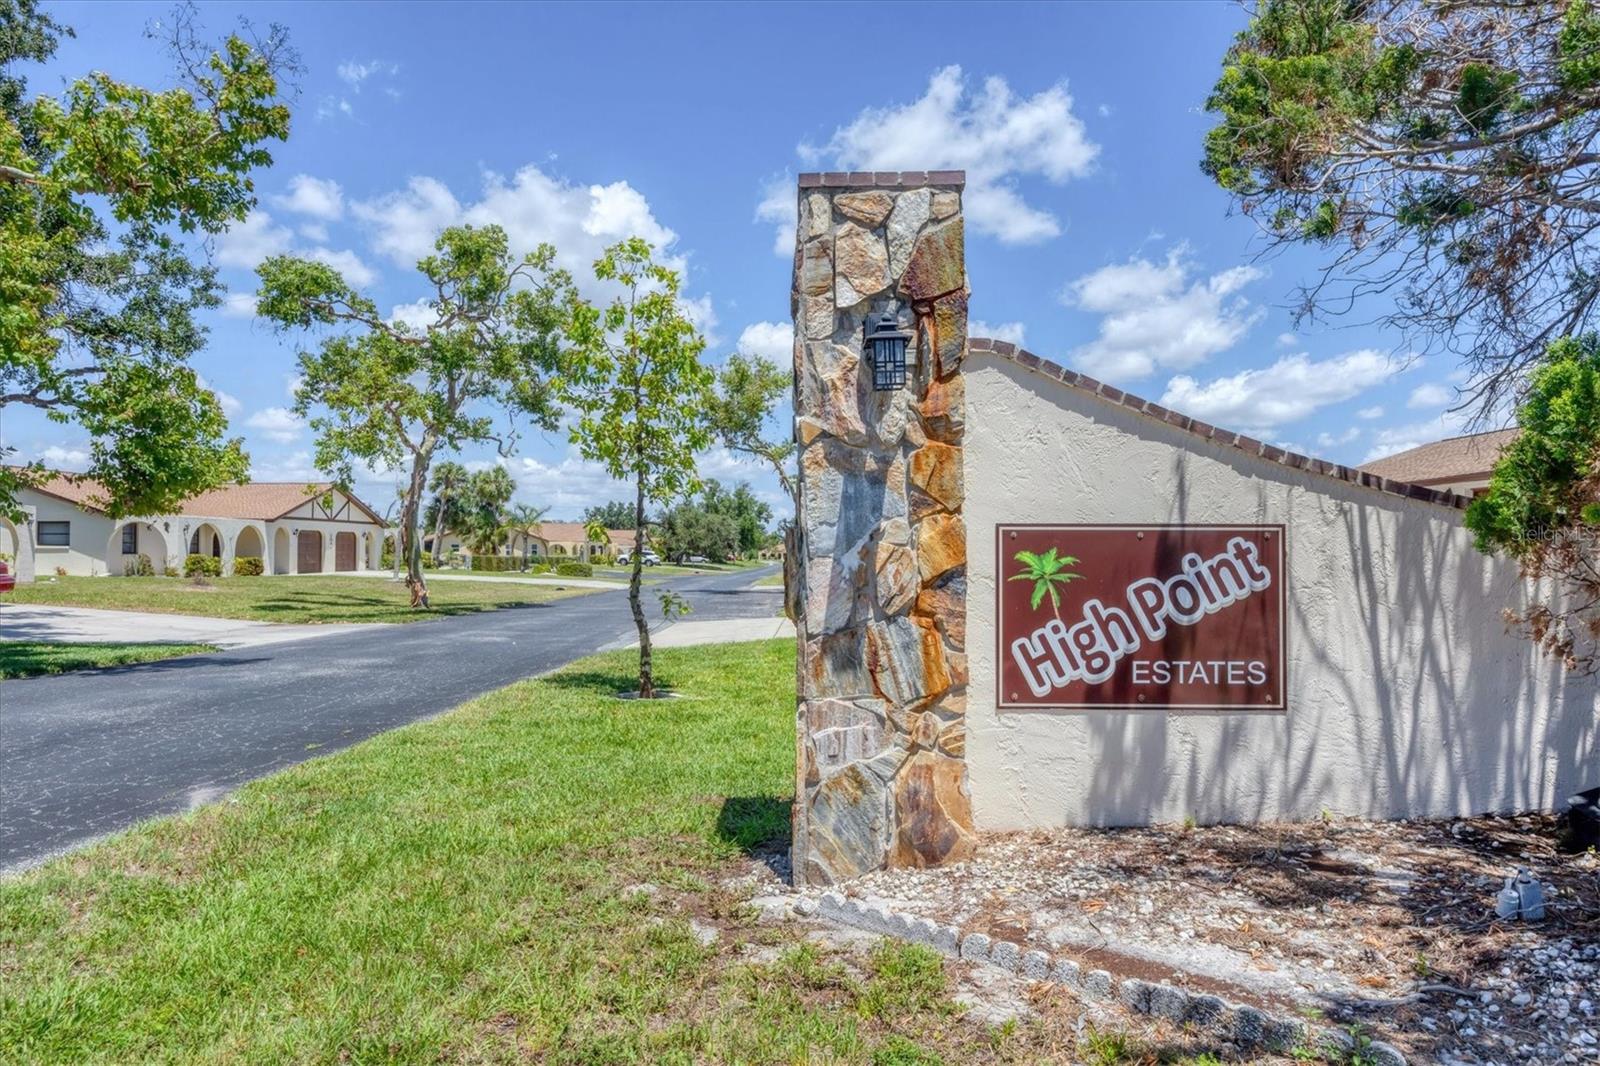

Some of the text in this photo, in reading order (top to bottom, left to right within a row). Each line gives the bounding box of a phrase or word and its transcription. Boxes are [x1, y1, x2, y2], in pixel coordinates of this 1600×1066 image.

[1012, 537, 1271, 697] High Point
[1132, 660, 1267, 685] ESTATES
